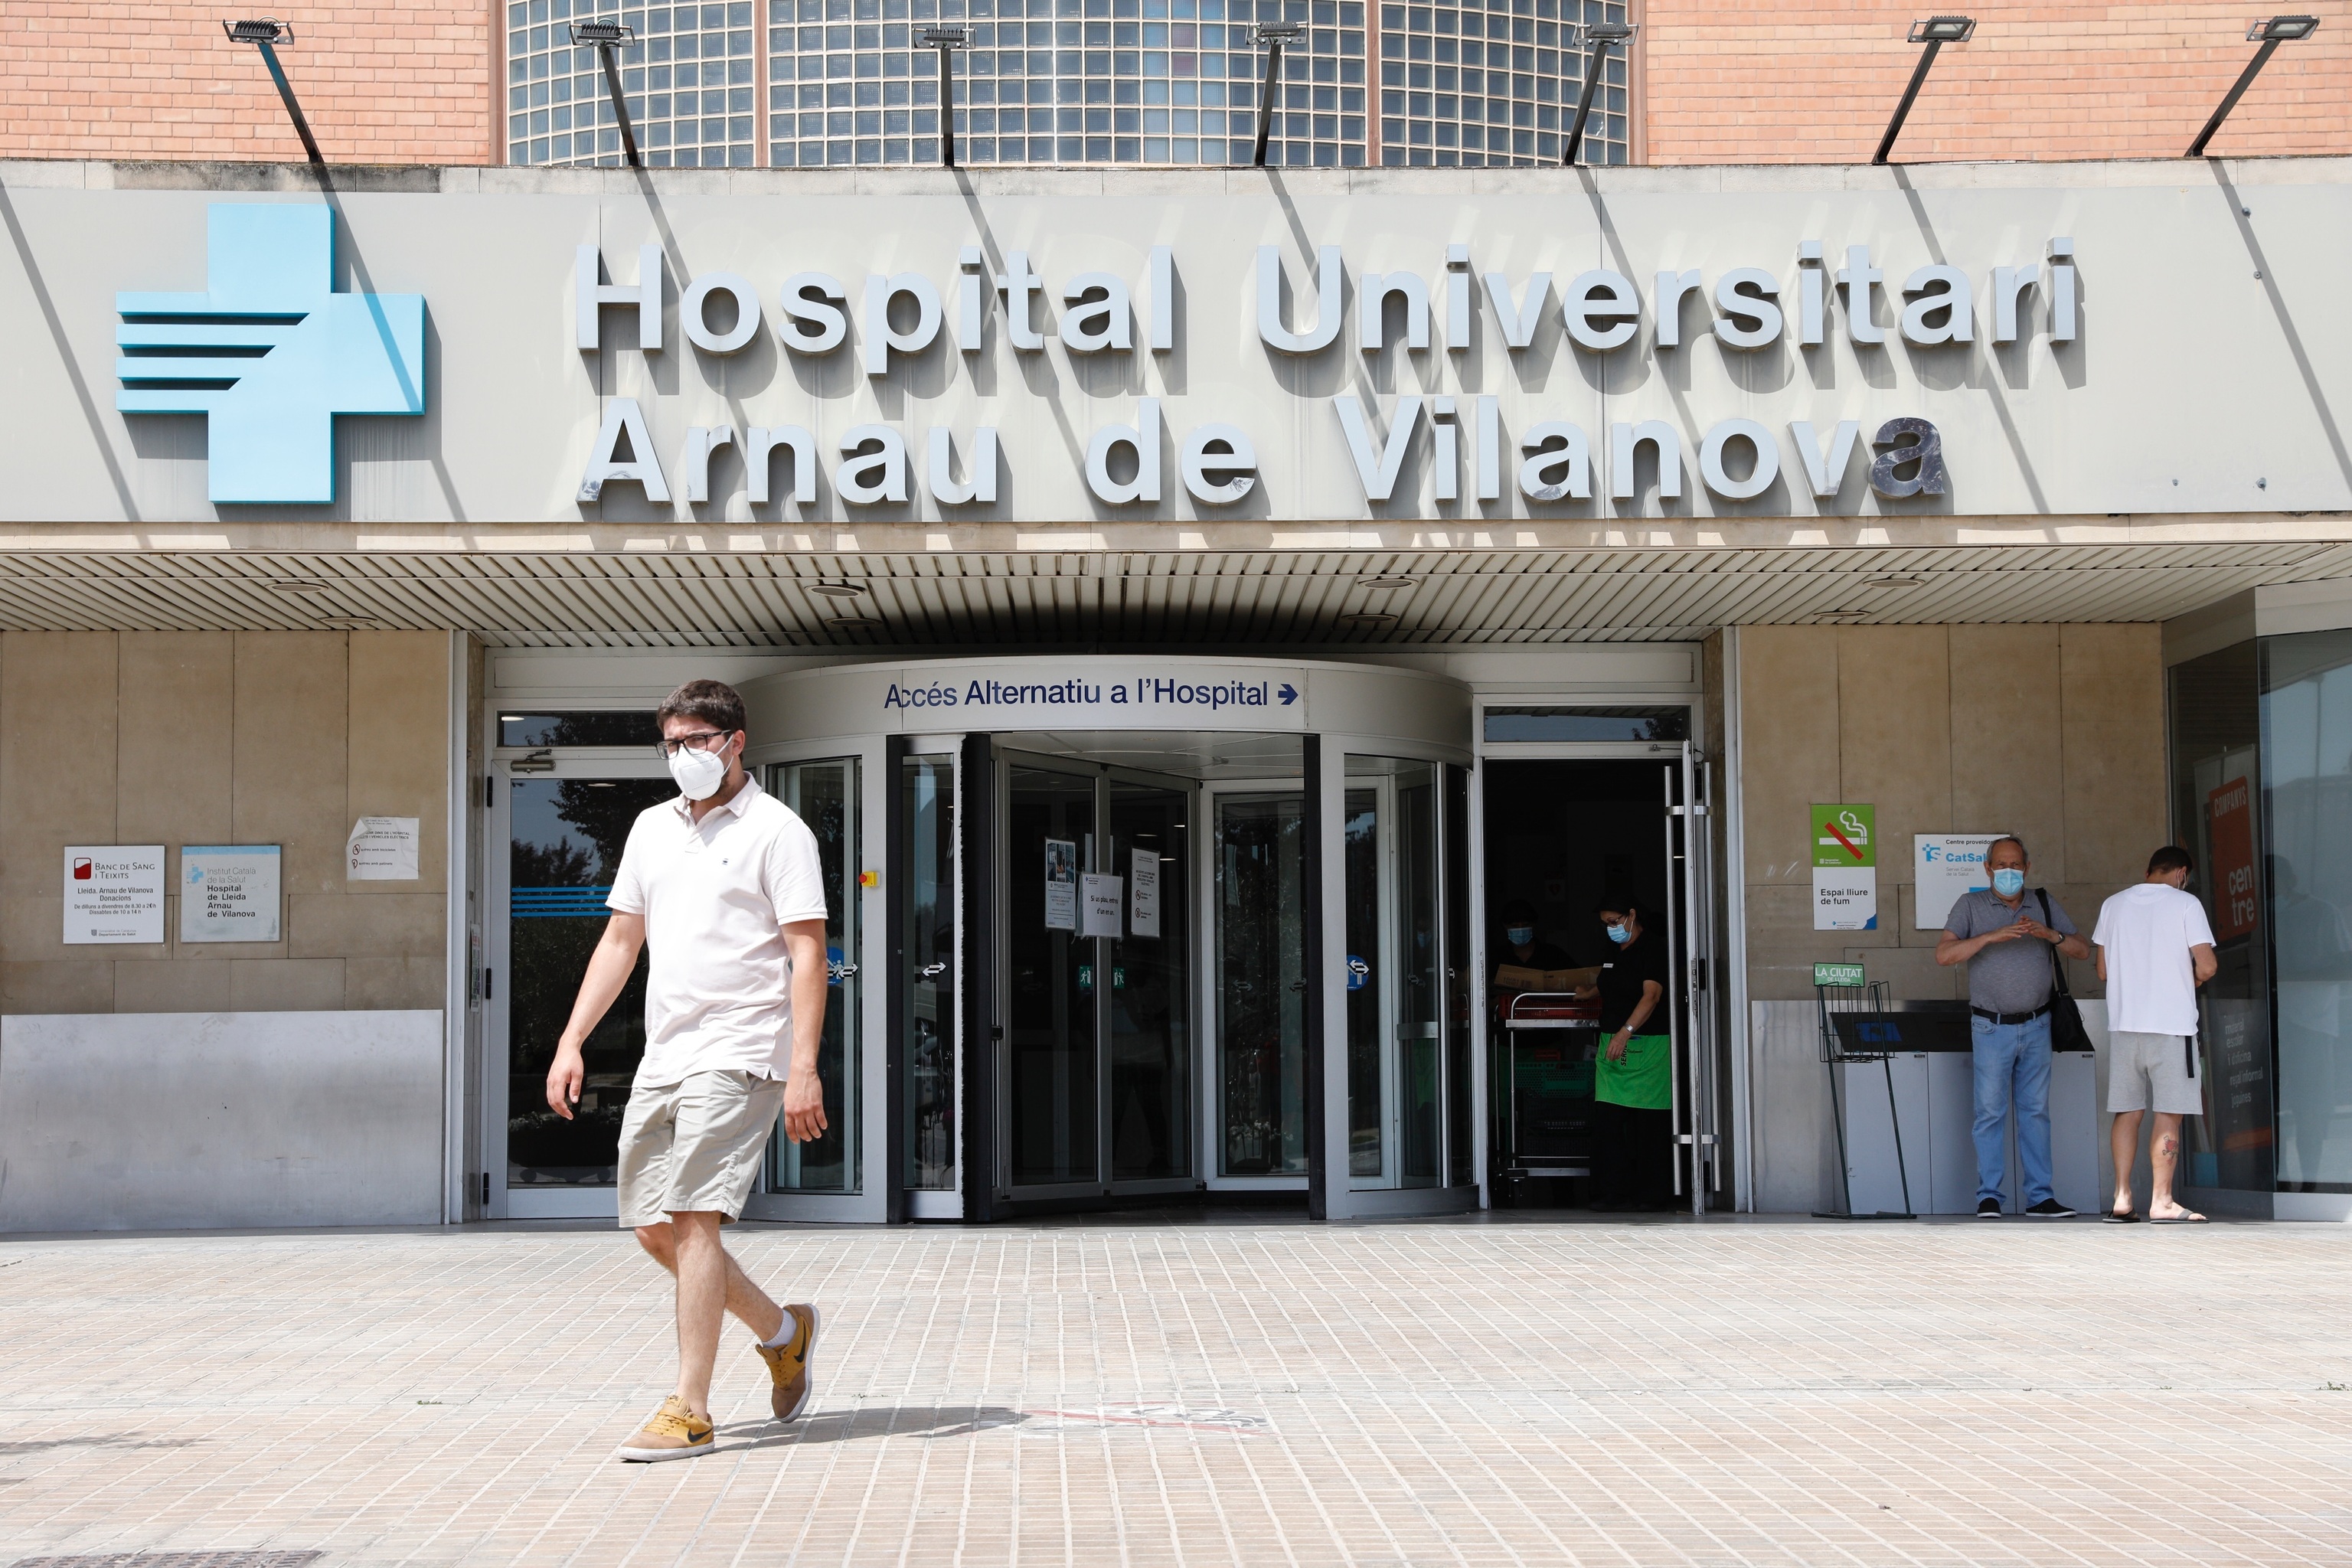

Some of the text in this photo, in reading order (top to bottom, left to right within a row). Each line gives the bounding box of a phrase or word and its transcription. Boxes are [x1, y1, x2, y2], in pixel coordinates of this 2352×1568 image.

[576, 236, 2077, 378] Hospital Universitari
[575, 394, 1945, 508] Arnau de Vilanova
[884, 678, 1268, 710] Accés Alternatiu a l'Hospital
[2214, 785, 2247, 818] COMPANYS
[95, 862, 117, 871] BANC
[232, 867, 256, 875] Català
[100, 871, 129, 879] TEIXITS
[2229, 864, 2252, 896] cen
[207, 884, 241, 893] Hospital
[1821, 889, 1844, 897] Espai
[2232, 897, 2255, 926] tre
[1815, 967, 1862, 978] LA CIUTAT
[2242, 1067, 2263, 1083] informal
